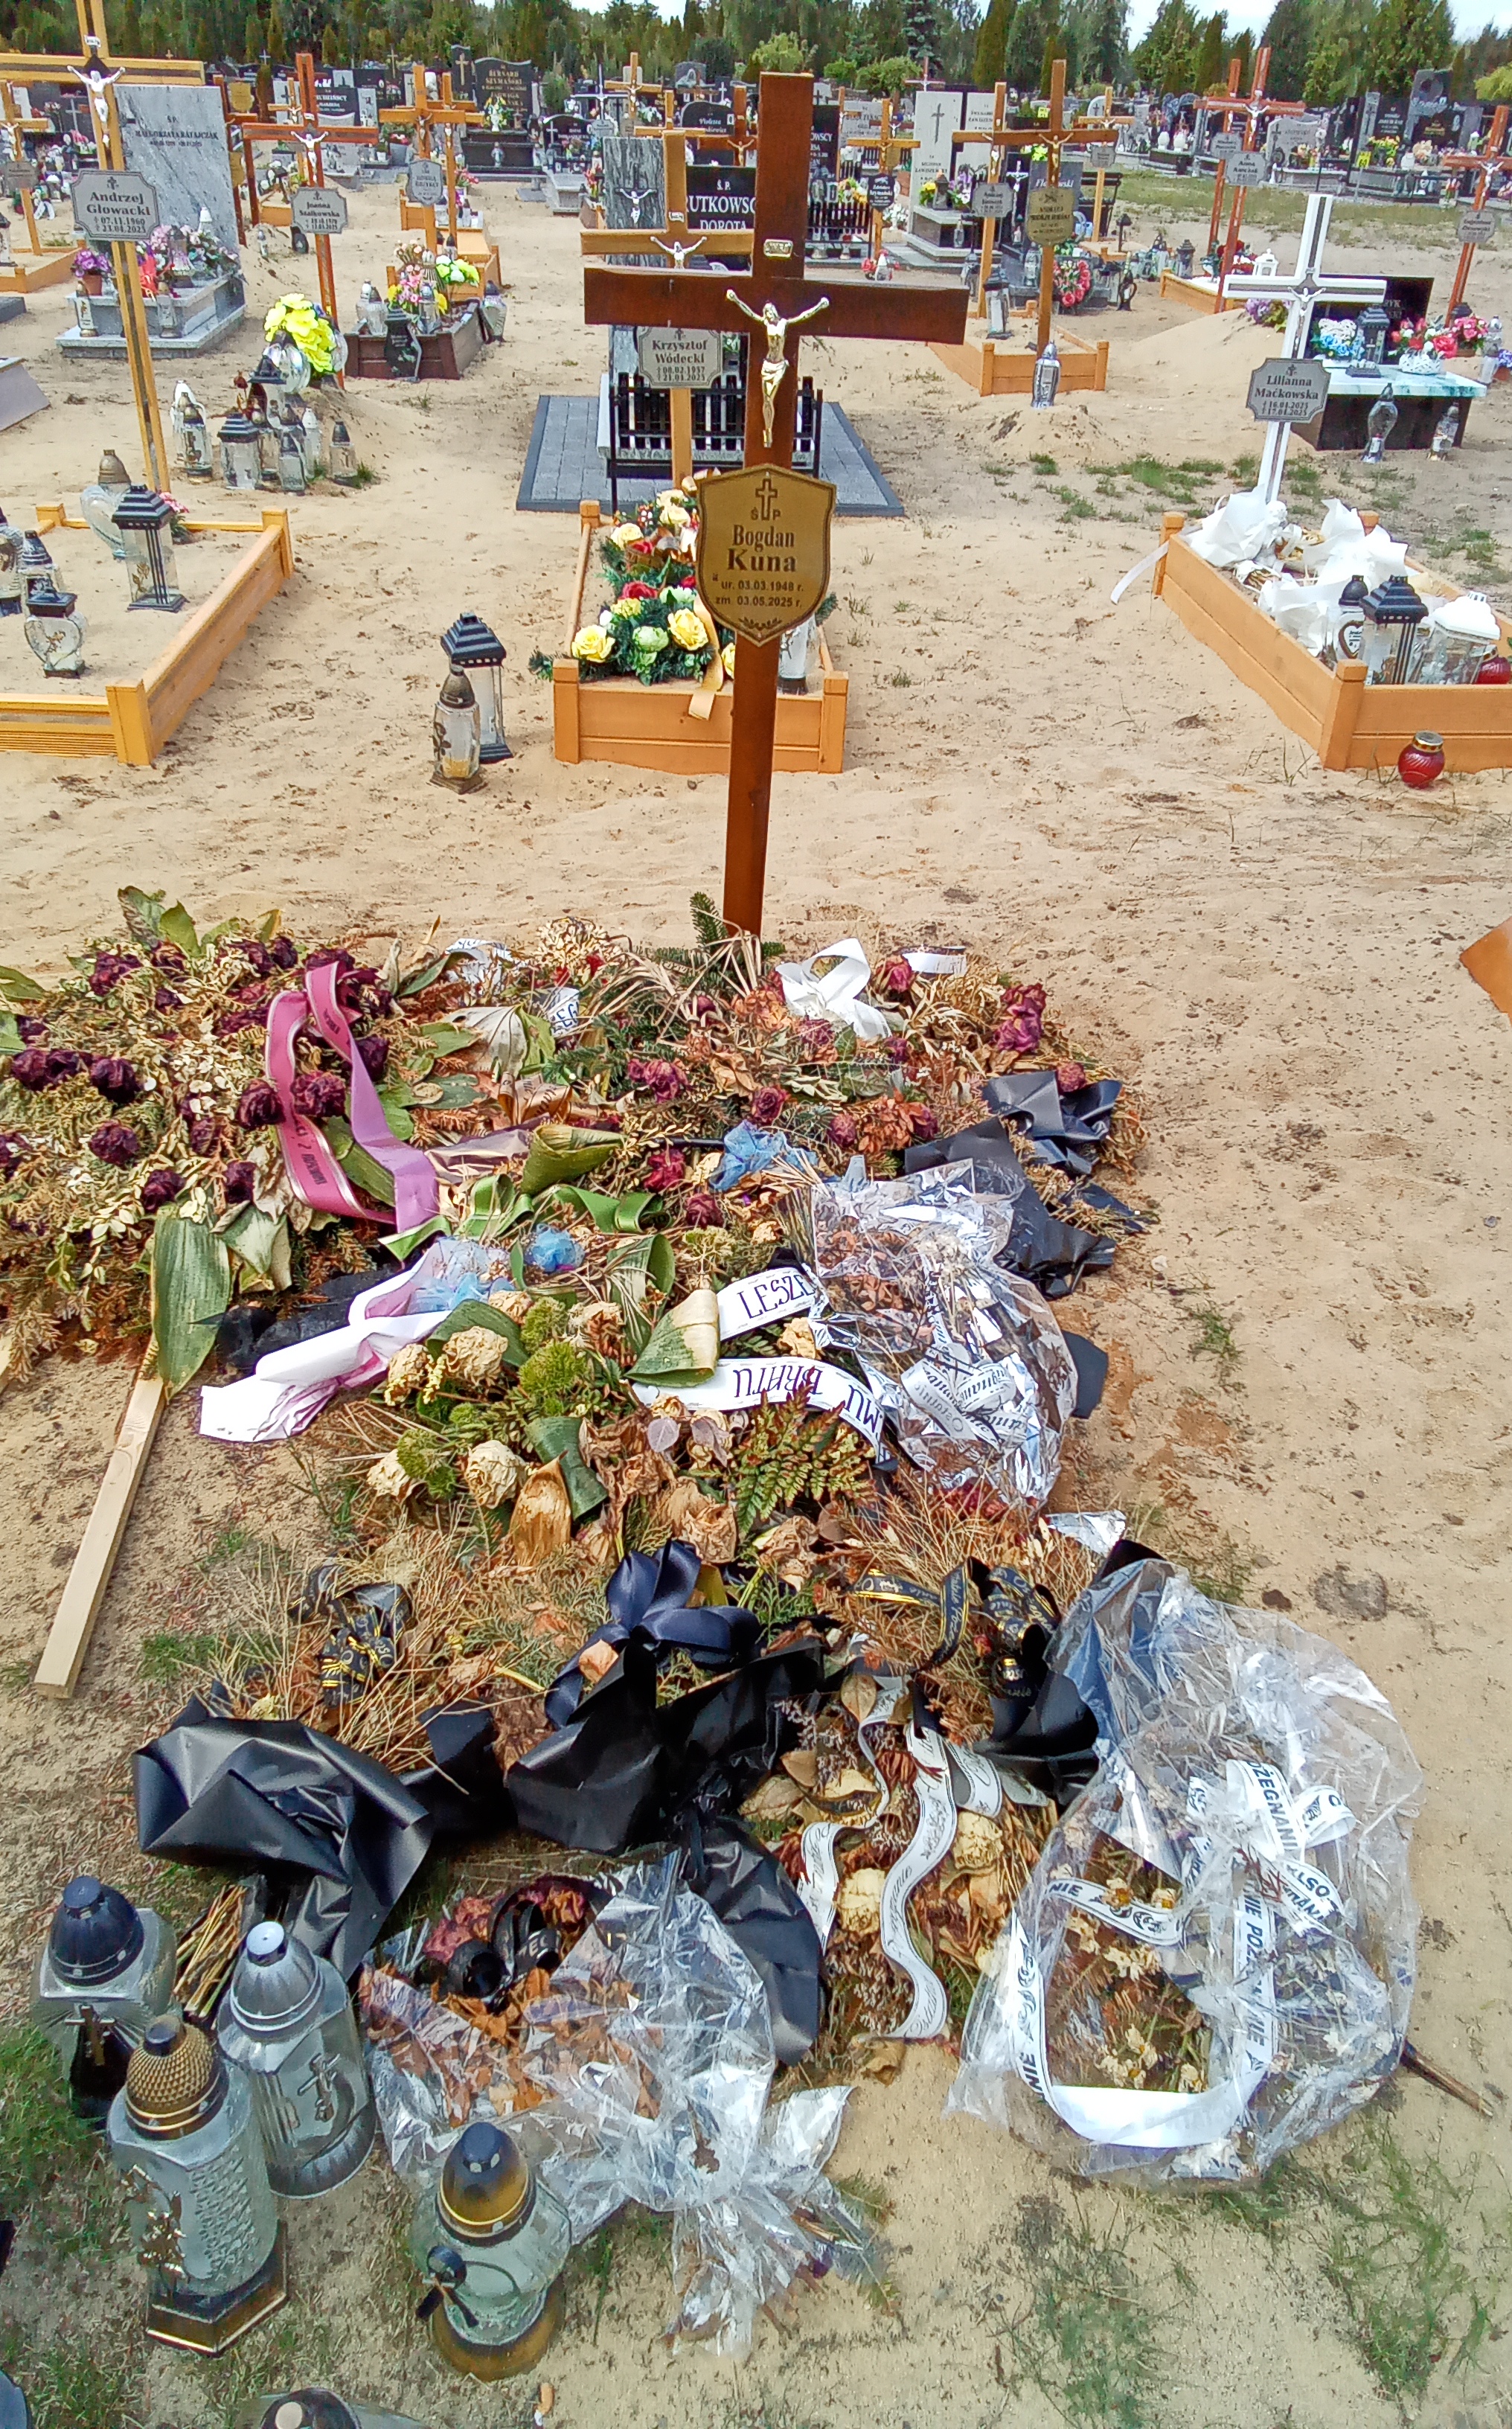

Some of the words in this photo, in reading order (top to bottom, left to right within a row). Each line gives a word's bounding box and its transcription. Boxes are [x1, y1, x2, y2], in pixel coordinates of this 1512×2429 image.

[652, 339, 708, 352] Krzysztof
[655, 352, 705, 364] Wódecki
[732, 524, 795, 552] Bogdan
[727, 548, 797, 572] Kuna
[737, 595, 793, 608] 03.05.2025
